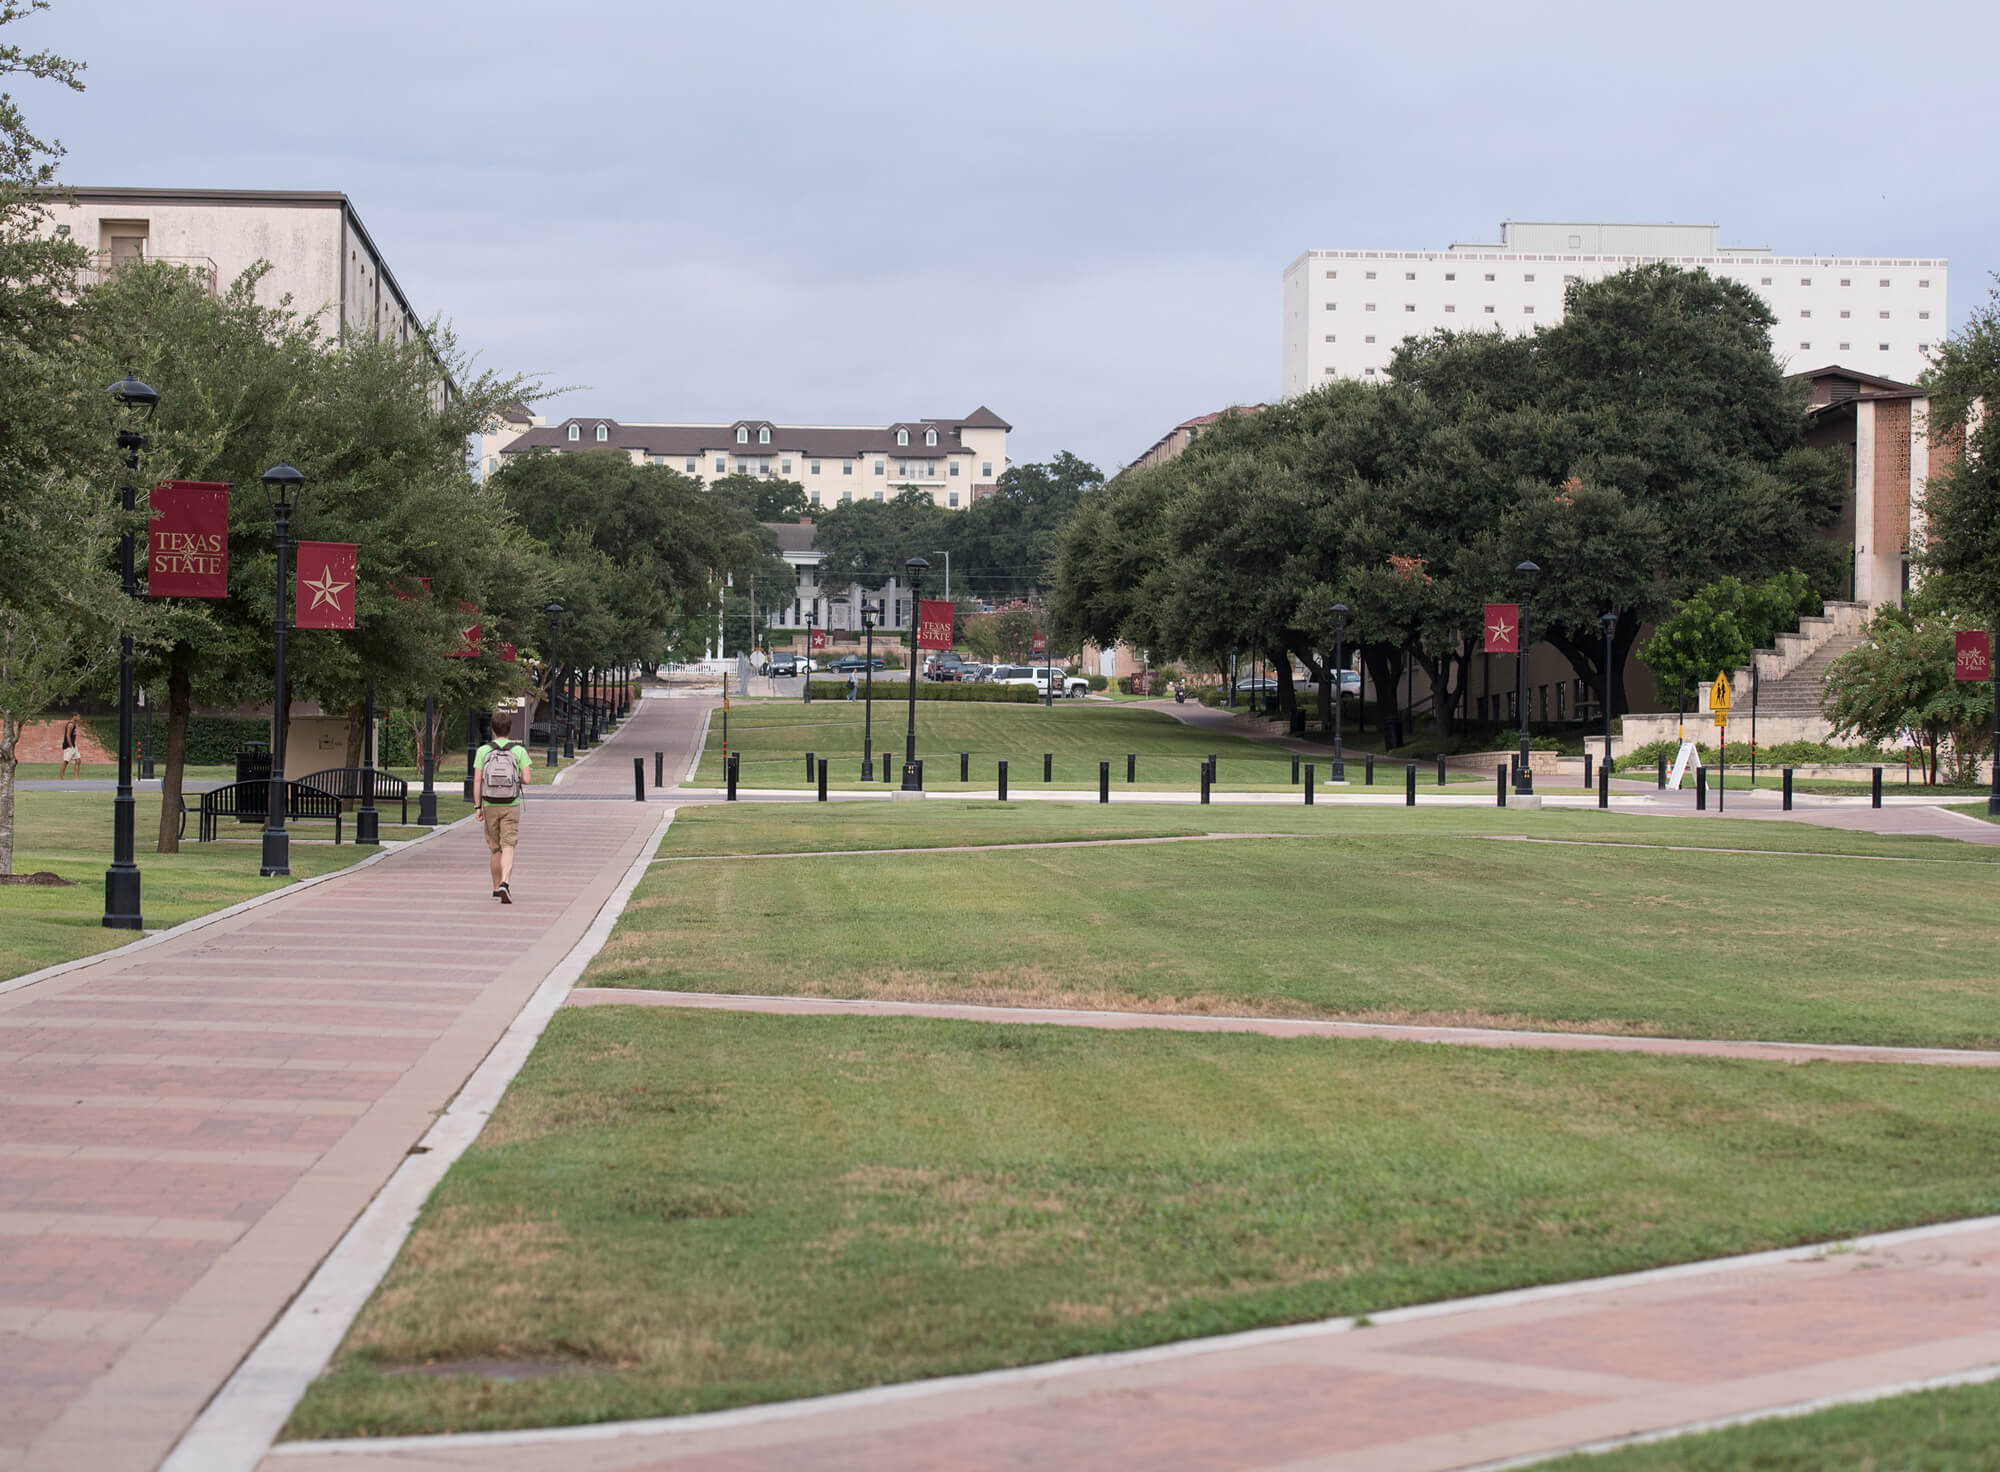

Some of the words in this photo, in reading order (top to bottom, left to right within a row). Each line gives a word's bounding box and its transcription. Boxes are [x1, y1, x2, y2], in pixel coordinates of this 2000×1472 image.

[155, 532, 222, 552] TEXAS
[155, 555, 221, 574] STATE
[922, 621, 951, 632] TEXAS
[922, 631, 951, 641] STATE
[1957, 656, 1987, 666] STAR
